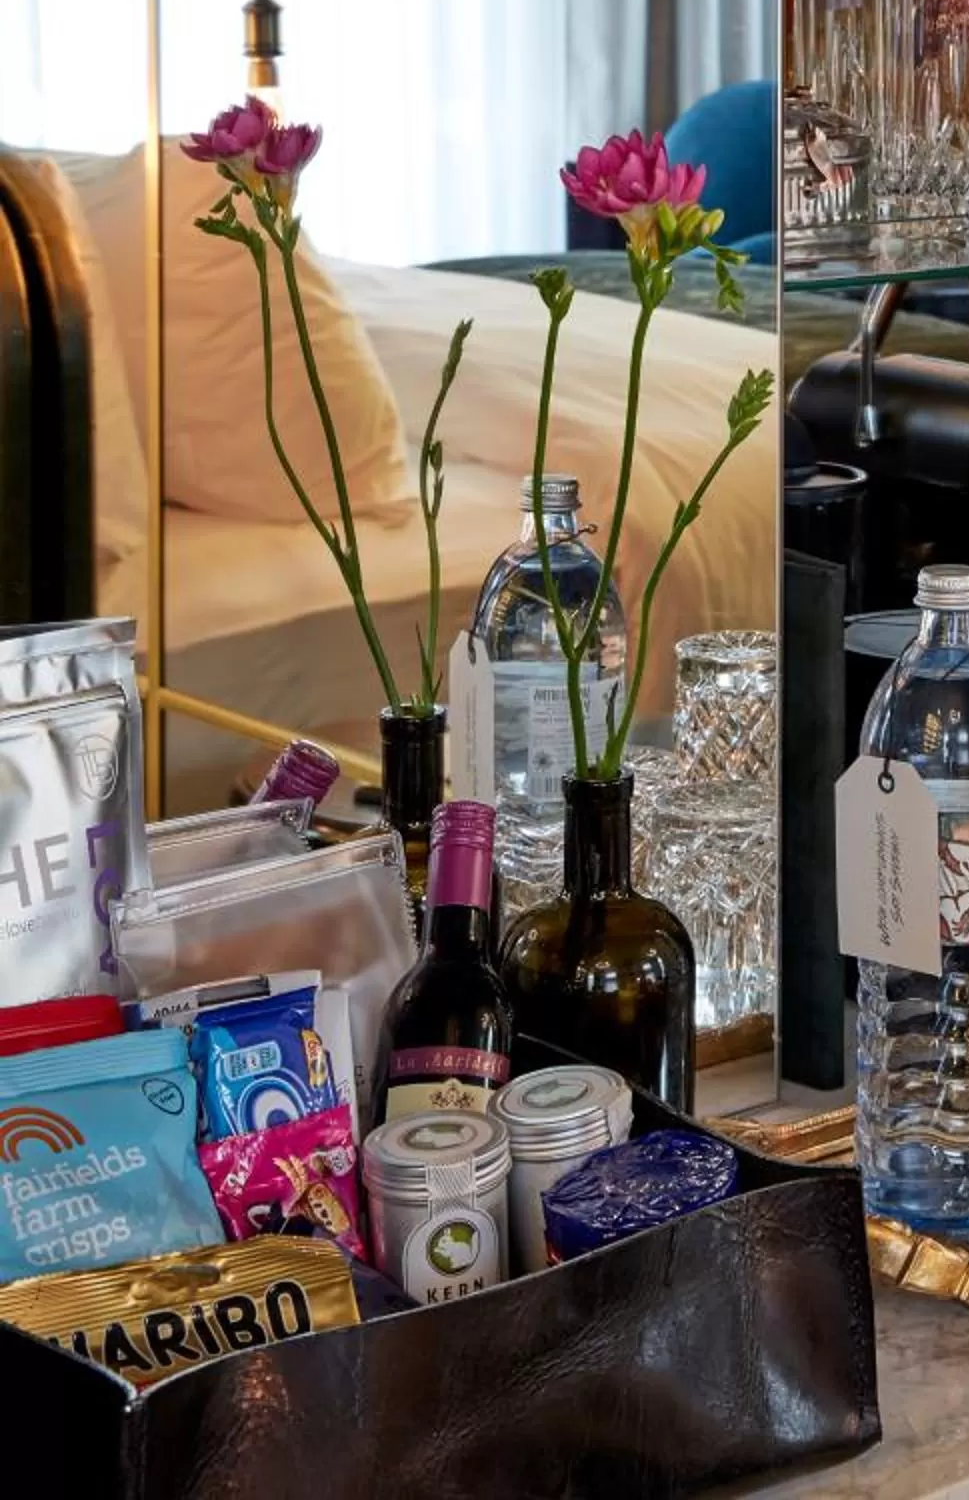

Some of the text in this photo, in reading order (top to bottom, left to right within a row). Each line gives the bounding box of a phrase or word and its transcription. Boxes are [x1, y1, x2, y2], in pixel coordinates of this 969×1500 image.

[0, 832, 76, 908] HE
[2, 1145, 147, 1208] fairfields
[11, 1193, 102, 1241] farm
[25, 1215, 131, 1267] crisps
[427, 1276, 484, 1304] KERN
